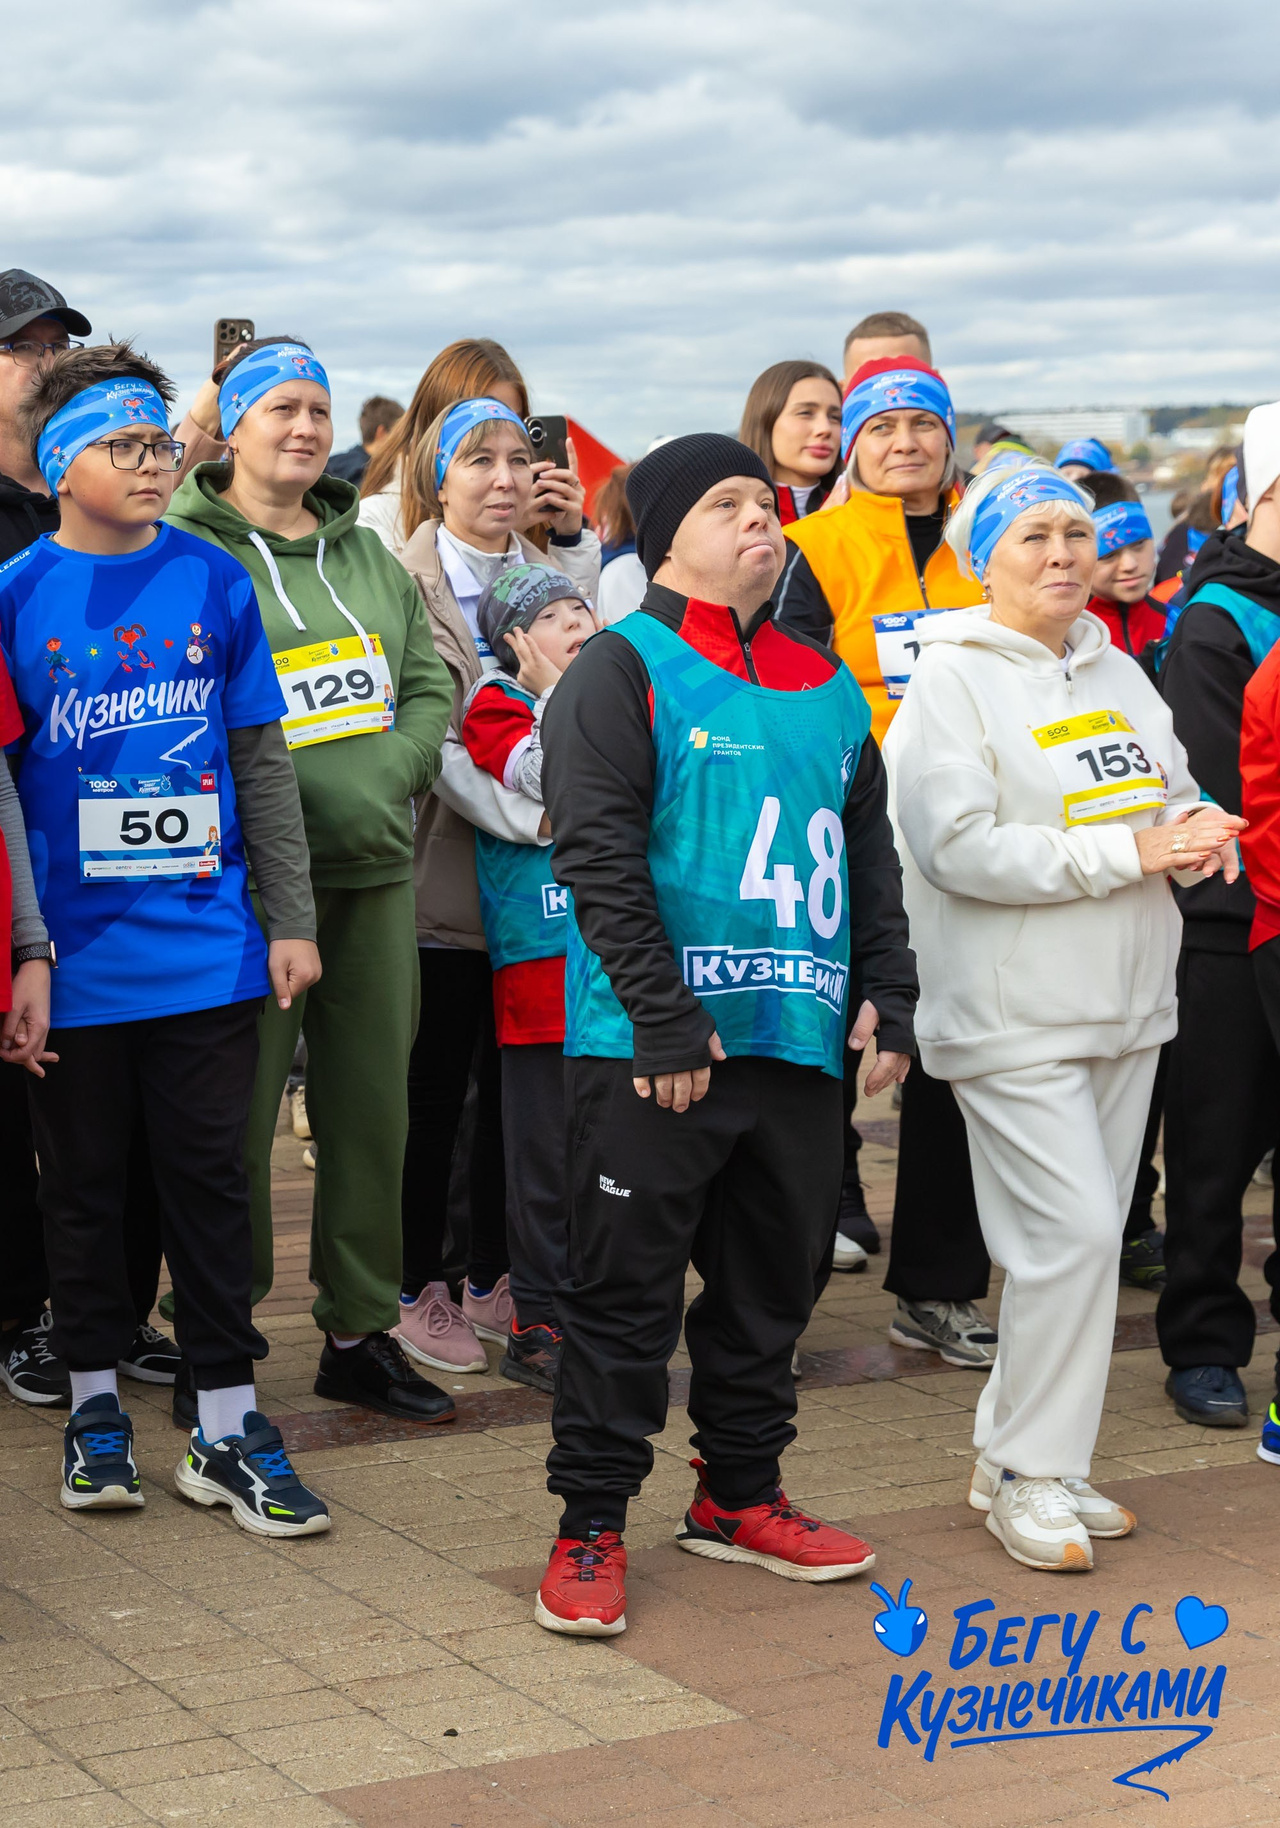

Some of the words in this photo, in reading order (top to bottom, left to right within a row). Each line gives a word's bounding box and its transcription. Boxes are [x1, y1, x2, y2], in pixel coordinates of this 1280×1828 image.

[0, 550, 31, 573] LEAGUE
[291, 669, 375, 711] 129
[1047, 725, 1069, 737] 500
[1076, 742, 1152, 782] 153
[89, 780, 118, 789] 1000
[120, 808, 189, 845] 50
[739, 796, 844, 939] 48
[599, 1183, 632, 1197] LEAGUE
